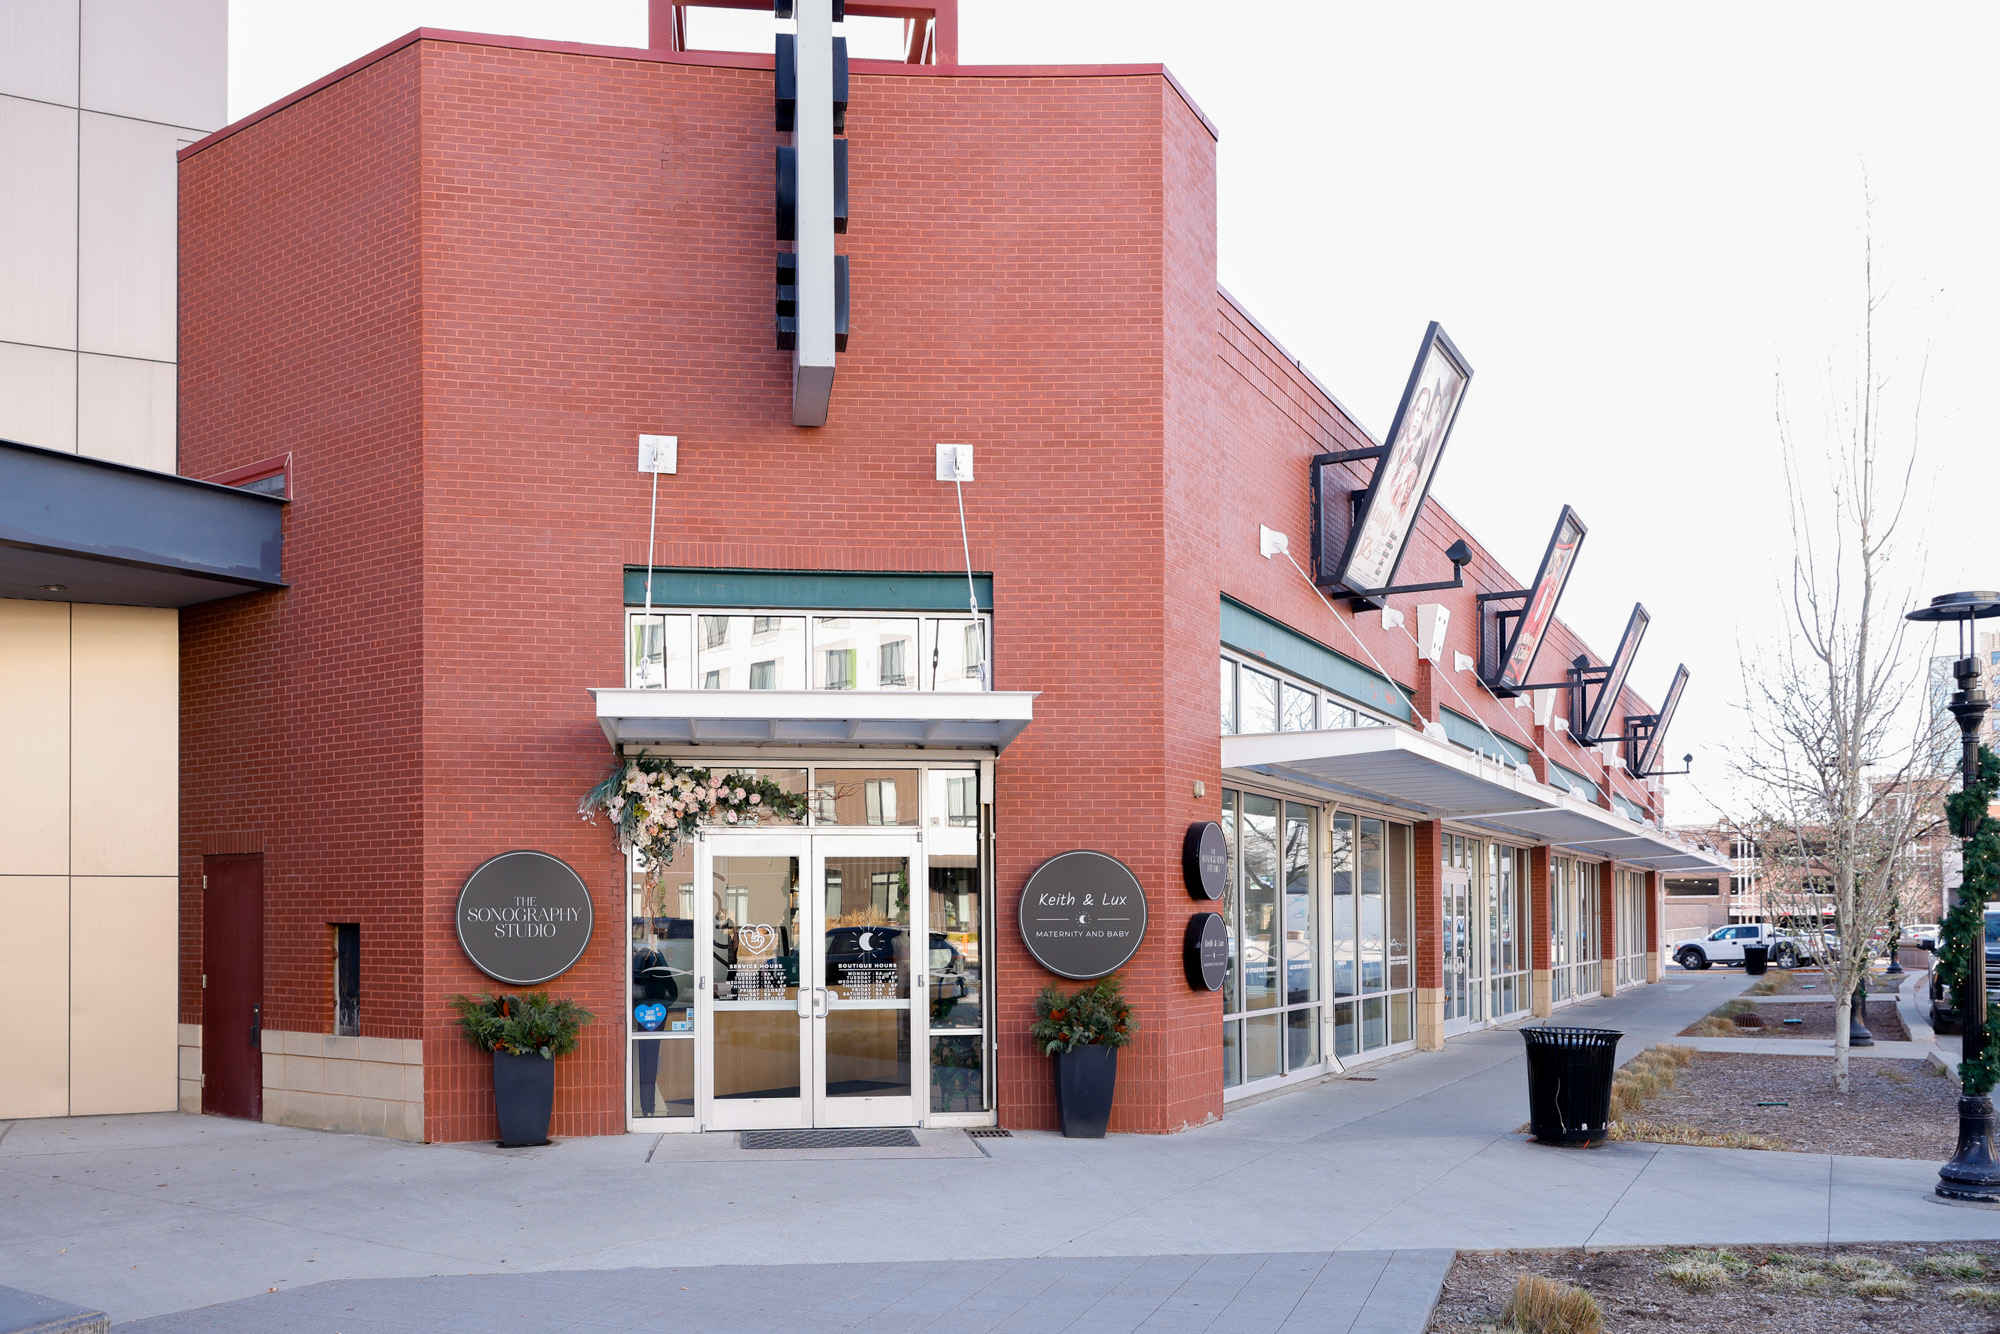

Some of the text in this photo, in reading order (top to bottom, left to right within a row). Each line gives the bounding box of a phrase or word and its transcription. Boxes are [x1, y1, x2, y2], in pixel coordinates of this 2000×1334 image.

[514, 896, 537, 906] THE
[1039, 892, 1127, 906] Keith & Lux
[467, 907, 581, 922] SONOGRAPHY
[494, 923, 556, 938] STUDIO
